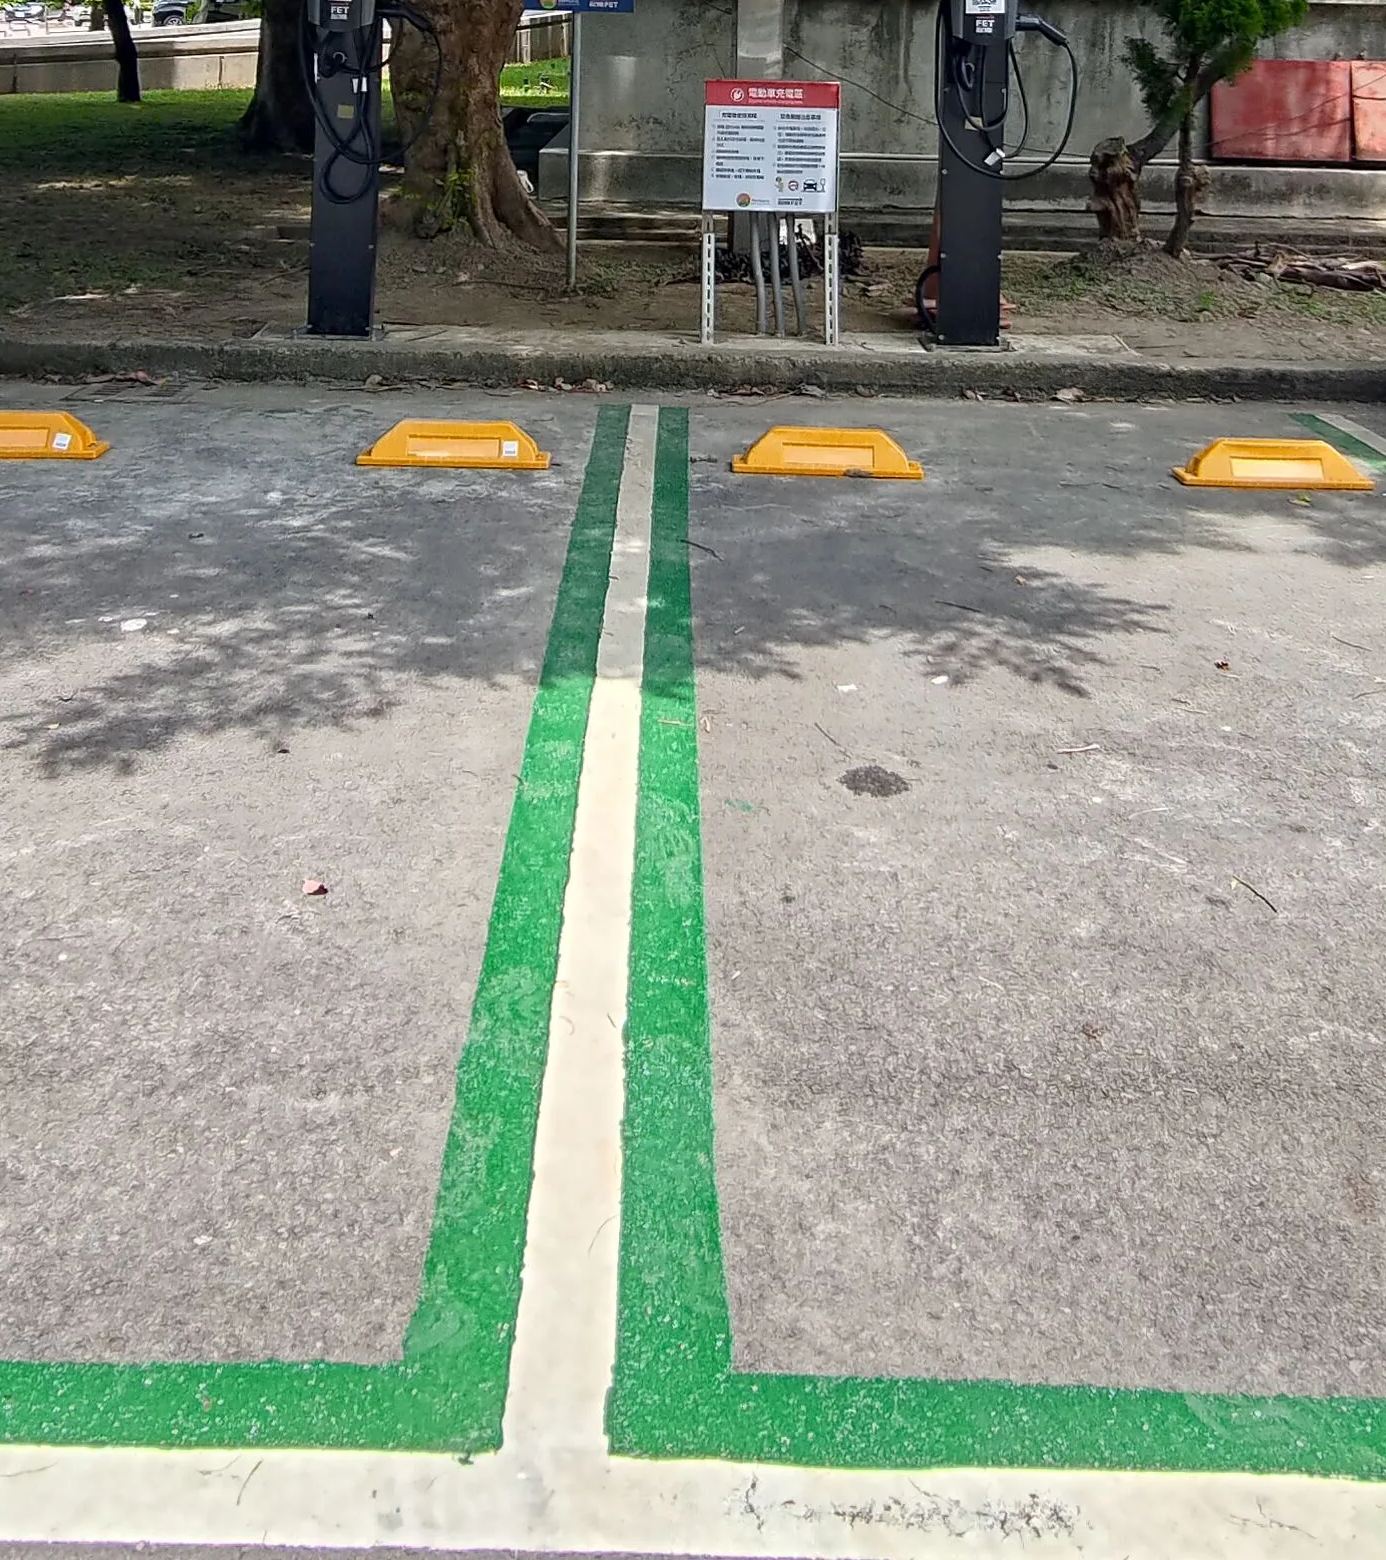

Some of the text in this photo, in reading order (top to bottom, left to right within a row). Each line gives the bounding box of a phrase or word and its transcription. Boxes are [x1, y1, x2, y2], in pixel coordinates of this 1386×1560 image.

[330, 6, 349, 14] FET
[975, 20, 995, 28] FET
[748, 87, 804, 99] 電動車充電區
